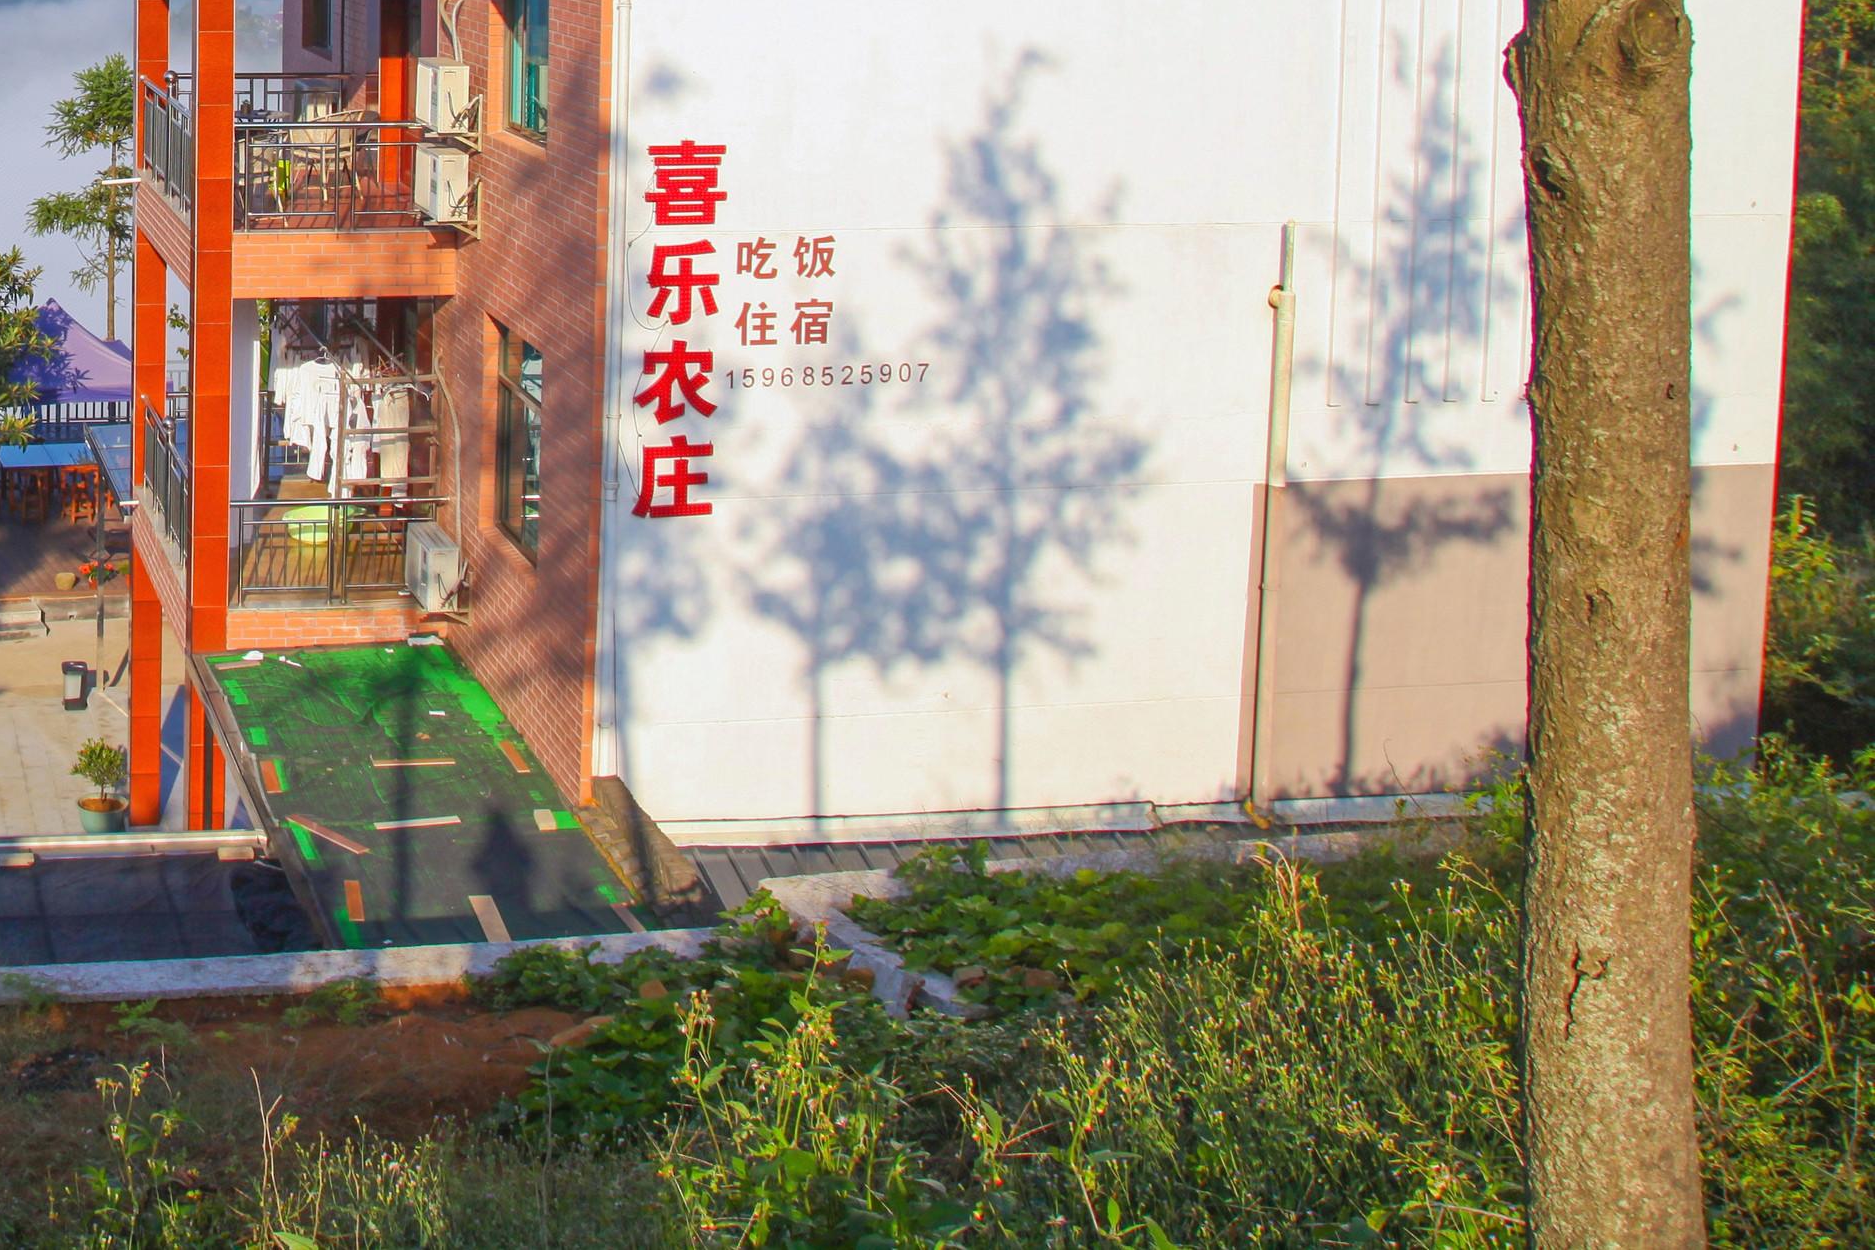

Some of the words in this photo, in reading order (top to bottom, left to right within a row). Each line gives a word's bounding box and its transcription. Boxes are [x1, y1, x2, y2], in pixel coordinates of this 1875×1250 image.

[736, 235, 836, 279] 吃饭
[631, 139, 727, 519] 喜乐农庄
[734, 298, 834, 346] 住宿
[725, 362, 930, 390] 15968525907
